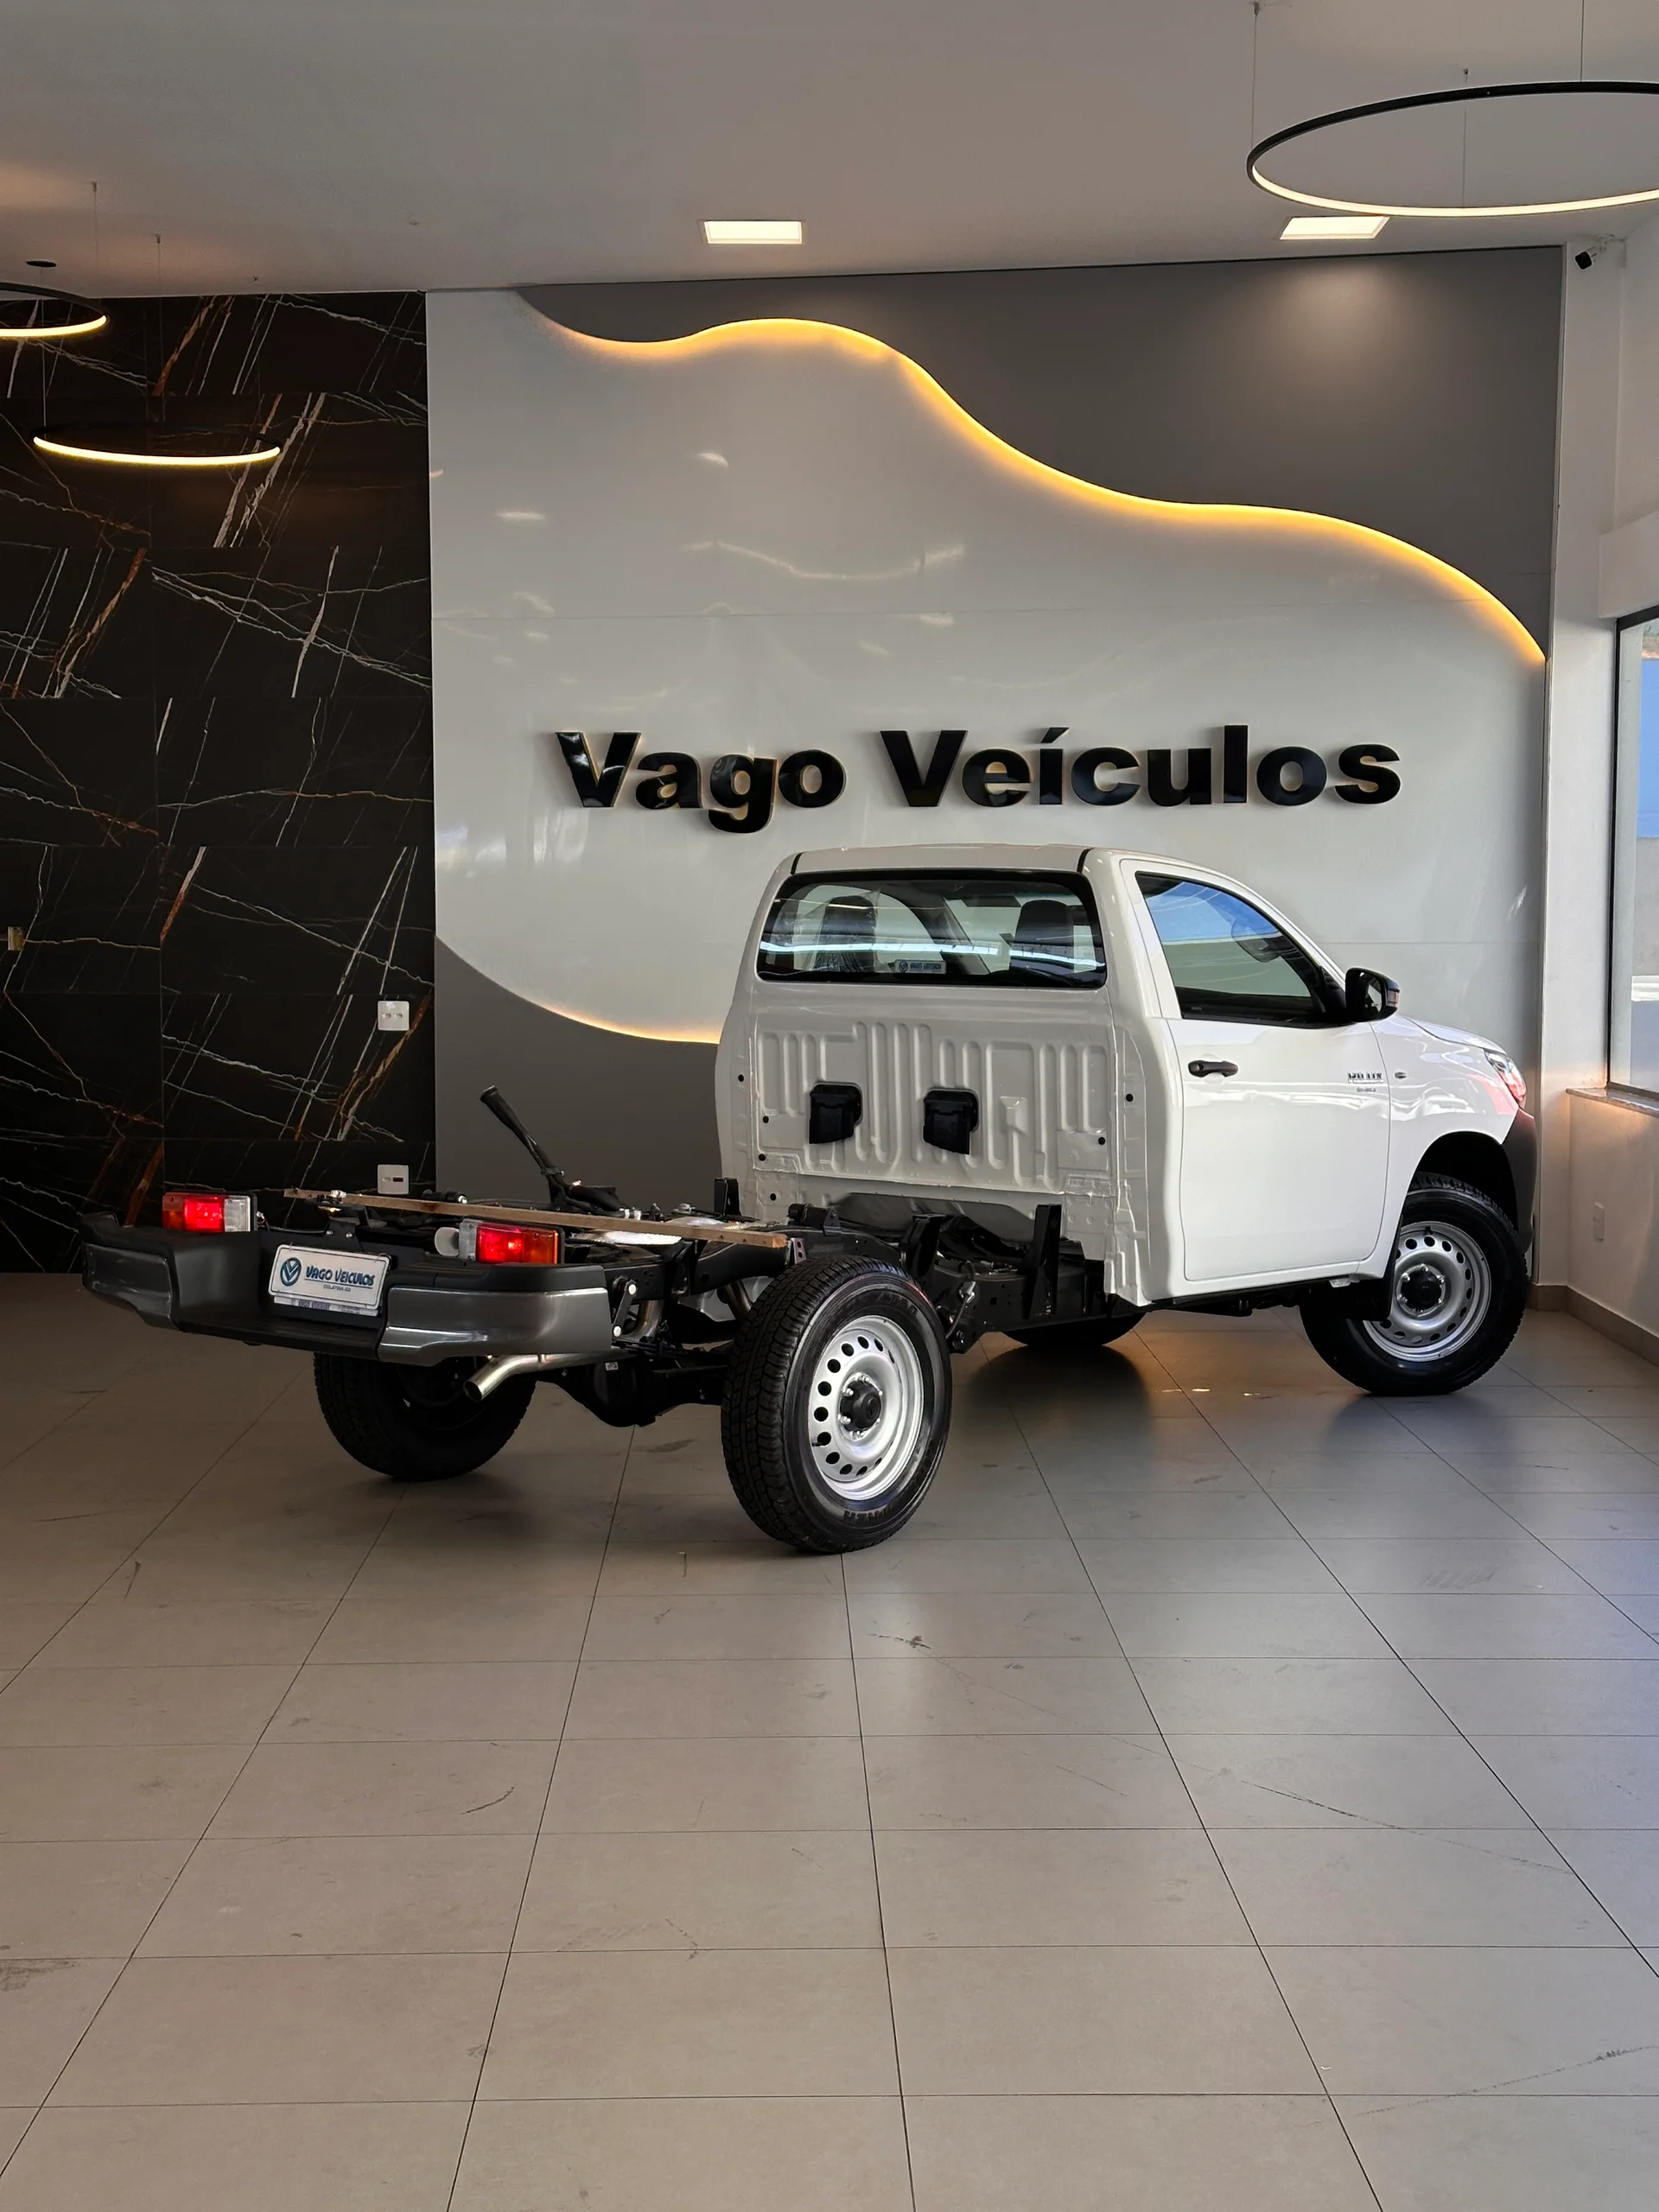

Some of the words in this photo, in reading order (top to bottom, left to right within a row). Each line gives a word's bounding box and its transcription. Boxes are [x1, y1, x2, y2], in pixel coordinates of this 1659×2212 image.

[555, 729, 848, 834] Vago
[880, 725, 1402, 808] Veículos
[306, 1265, 333, 1281] VAGO
